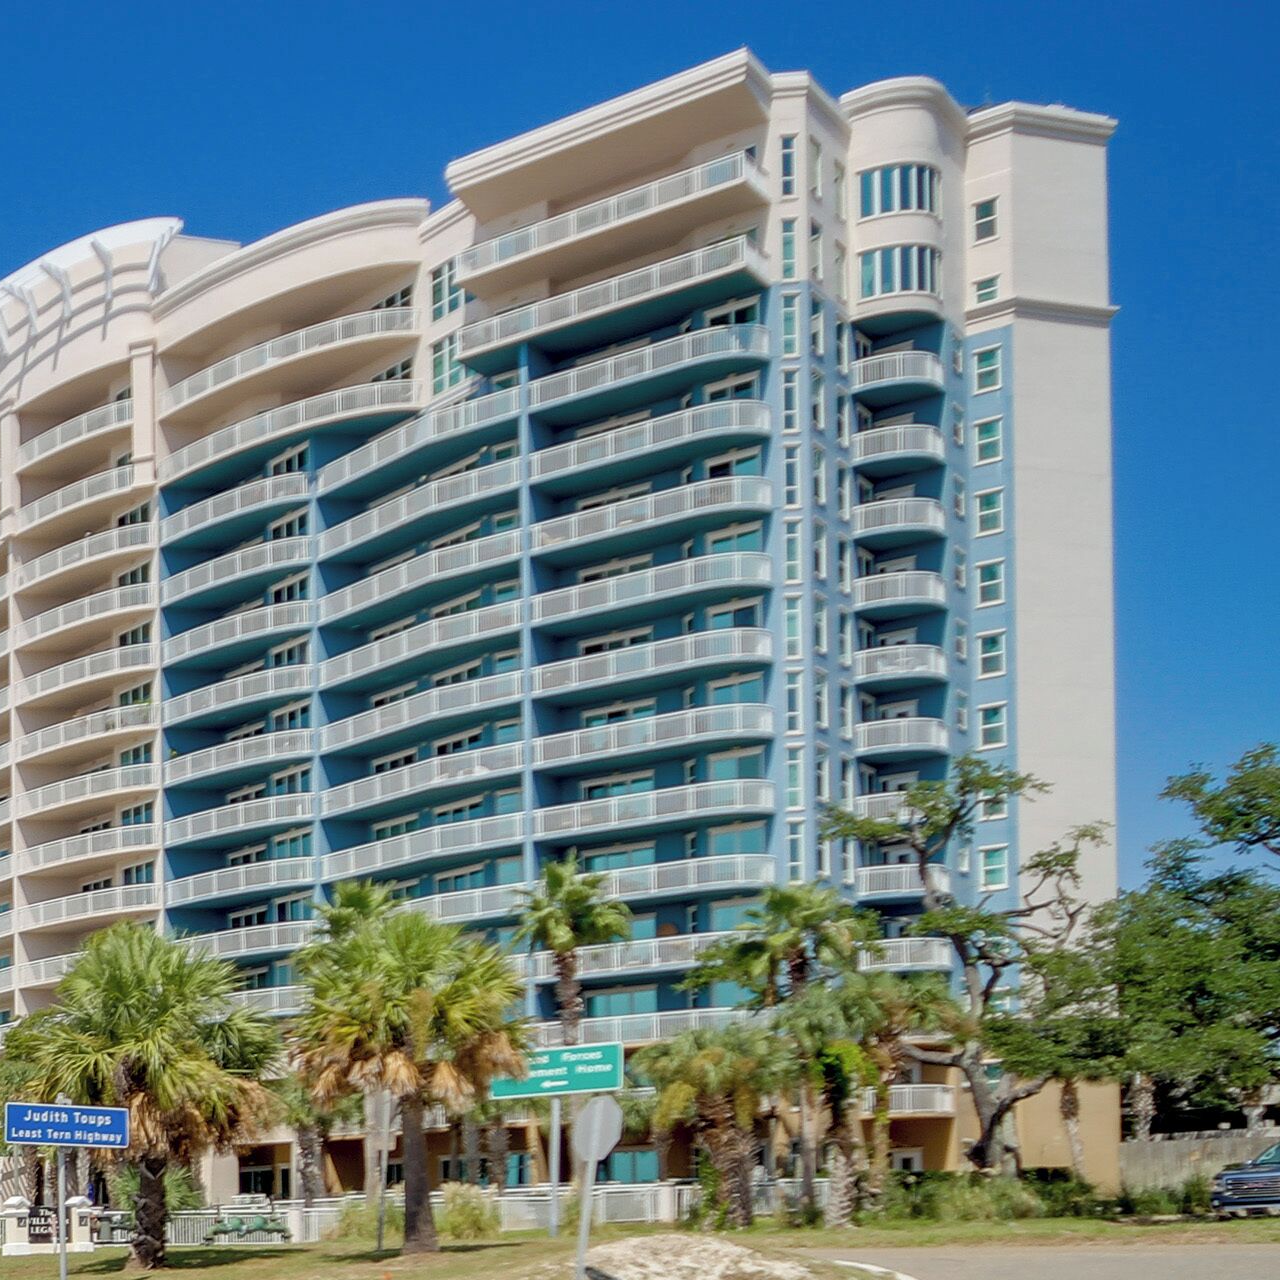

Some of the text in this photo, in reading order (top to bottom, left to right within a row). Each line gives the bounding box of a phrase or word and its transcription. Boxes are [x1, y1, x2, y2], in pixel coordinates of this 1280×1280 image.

[561, 1051, 603, 1062] Forces
[575, 1064, 613, 1074] Home
[24, 1109, 112, 1128] Judith Toups
[11, 1127, 122, 1144] Least Tern Highway
